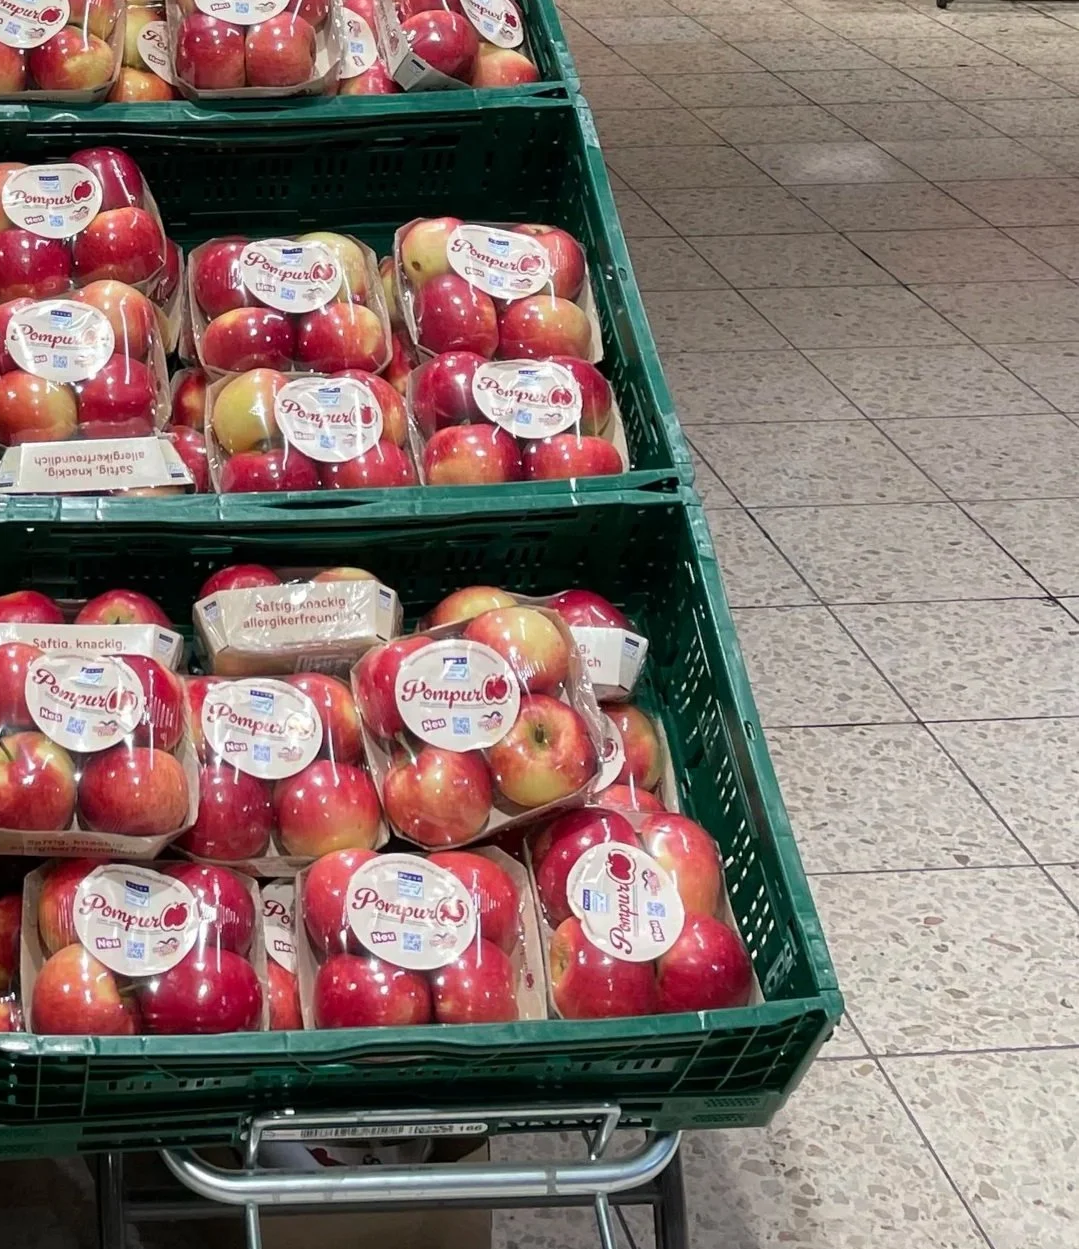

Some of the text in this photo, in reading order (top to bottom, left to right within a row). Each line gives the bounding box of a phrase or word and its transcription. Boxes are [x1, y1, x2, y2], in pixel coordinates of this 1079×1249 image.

[10, 189, 74, 207] Pompur
[244, 251, 311, 283] Pompur
[451, 238, 520, 275] Pompur
[280, 398, 351, 430] Pompur
[32, 668, 107, 709] Pompur
[401, 679, 484, 709] Pompur
[207, 702, 286, 736] Pompur
[421, 718, 446, 732] Neu
[79, 893, 161, 931] Pompur
[354, 887, 437, 925] Pompur
[609, 880, 632, 954] Pompur
[95, 936, 121, 950] Neu
[370, 930, 397, 945] Neu
[649, 920, 666, 943] Neu
